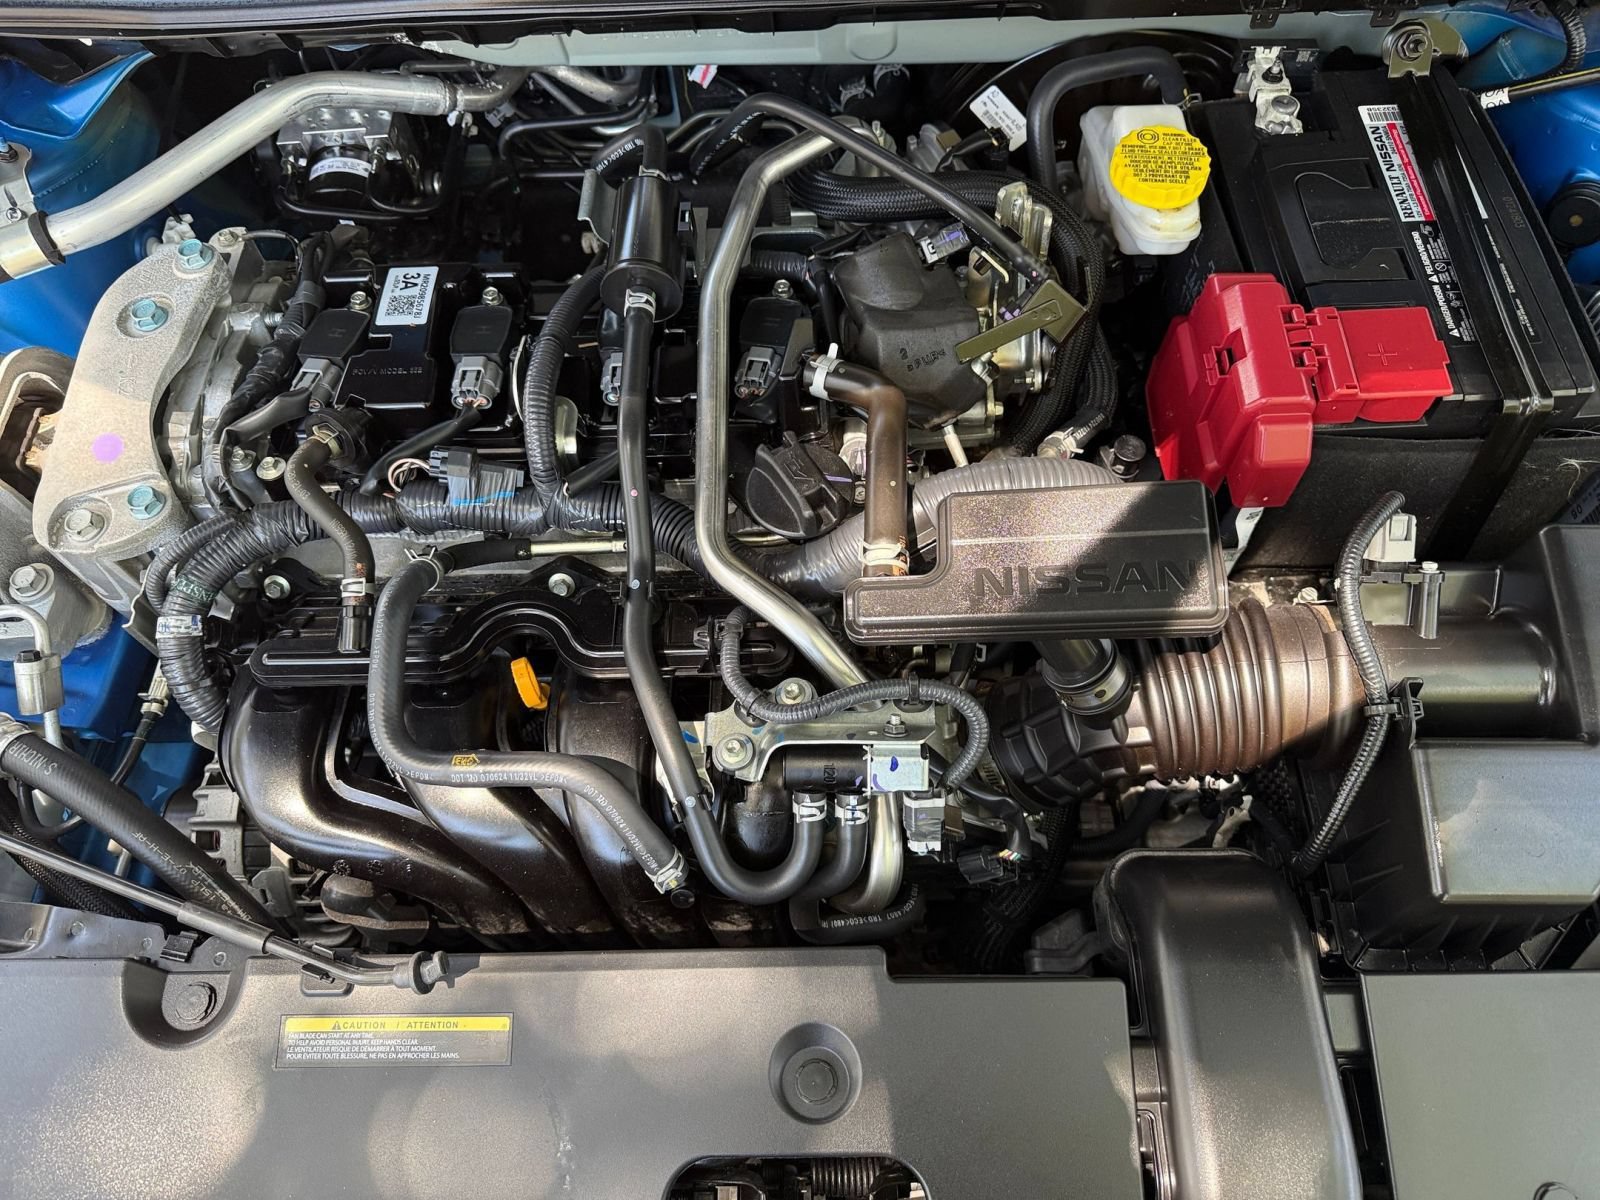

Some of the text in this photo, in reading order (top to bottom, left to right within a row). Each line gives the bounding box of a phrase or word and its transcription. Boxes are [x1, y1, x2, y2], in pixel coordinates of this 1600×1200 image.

[1368, 126, 1415, 217] RENAULT NISSAN
[400, 272, 421, 290] 3A
[974, 559, 1197, 598] NISSAN
